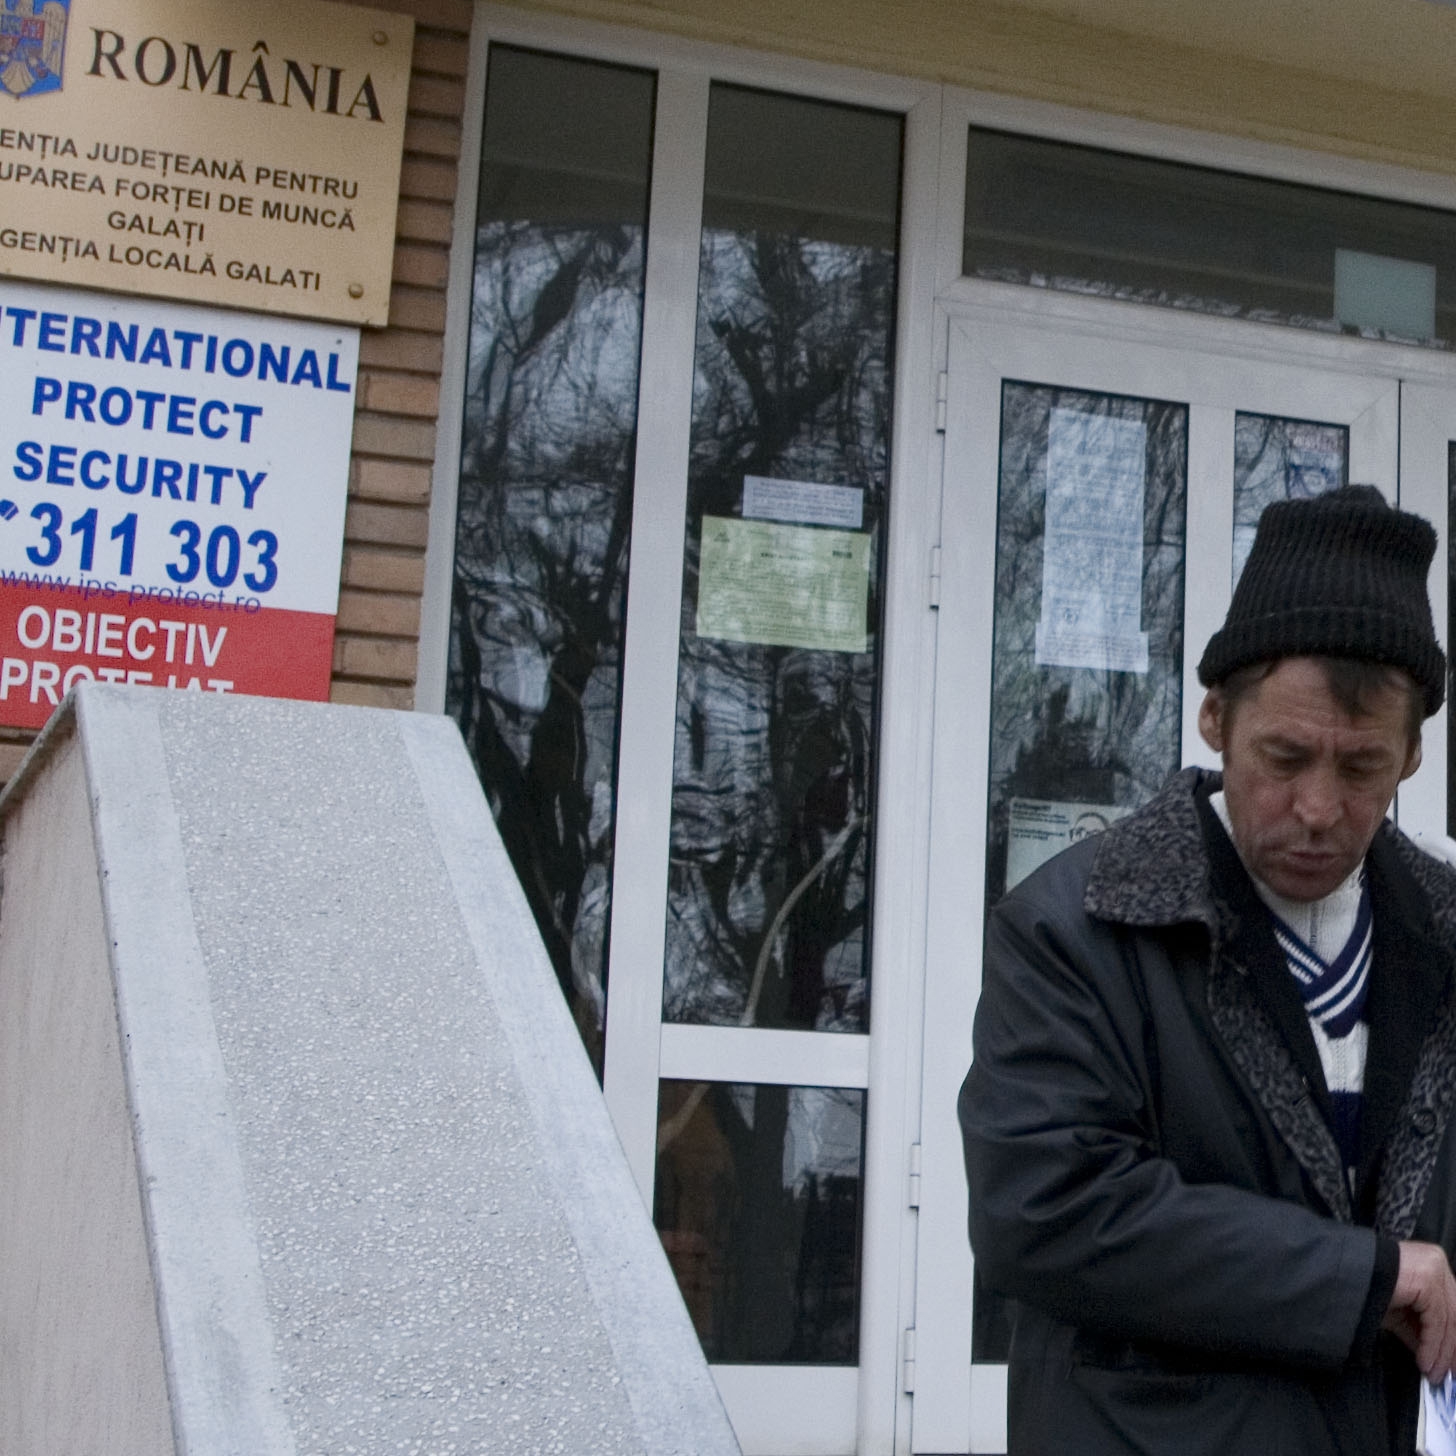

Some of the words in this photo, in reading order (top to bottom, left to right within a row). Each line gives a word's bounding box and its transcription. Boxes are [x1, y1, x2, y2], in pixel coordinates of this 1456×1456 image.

[86, 26, 386, 123] ROMÂNIA
[219, 194, 254, 216] DE
[262, 200, 356, 232] MUNCĂ
[255, 166, 358, 200] PENTRU
[109, 243, 217, 277] LOCALĂ
[226, 261, 321, 291] GALATI
[0, 306, 352, 393] TERNATIONAL
[32, 376, 263, 443] PROTECT
[13, 441, 267, 509] SECURITY
[26, 502, 138, 576] 311
[166, 520, 279, 593] 303
[0, 568, 262, 614] www.ips-protect.ro
[17, 605, 228, 667] OBIECTIV
